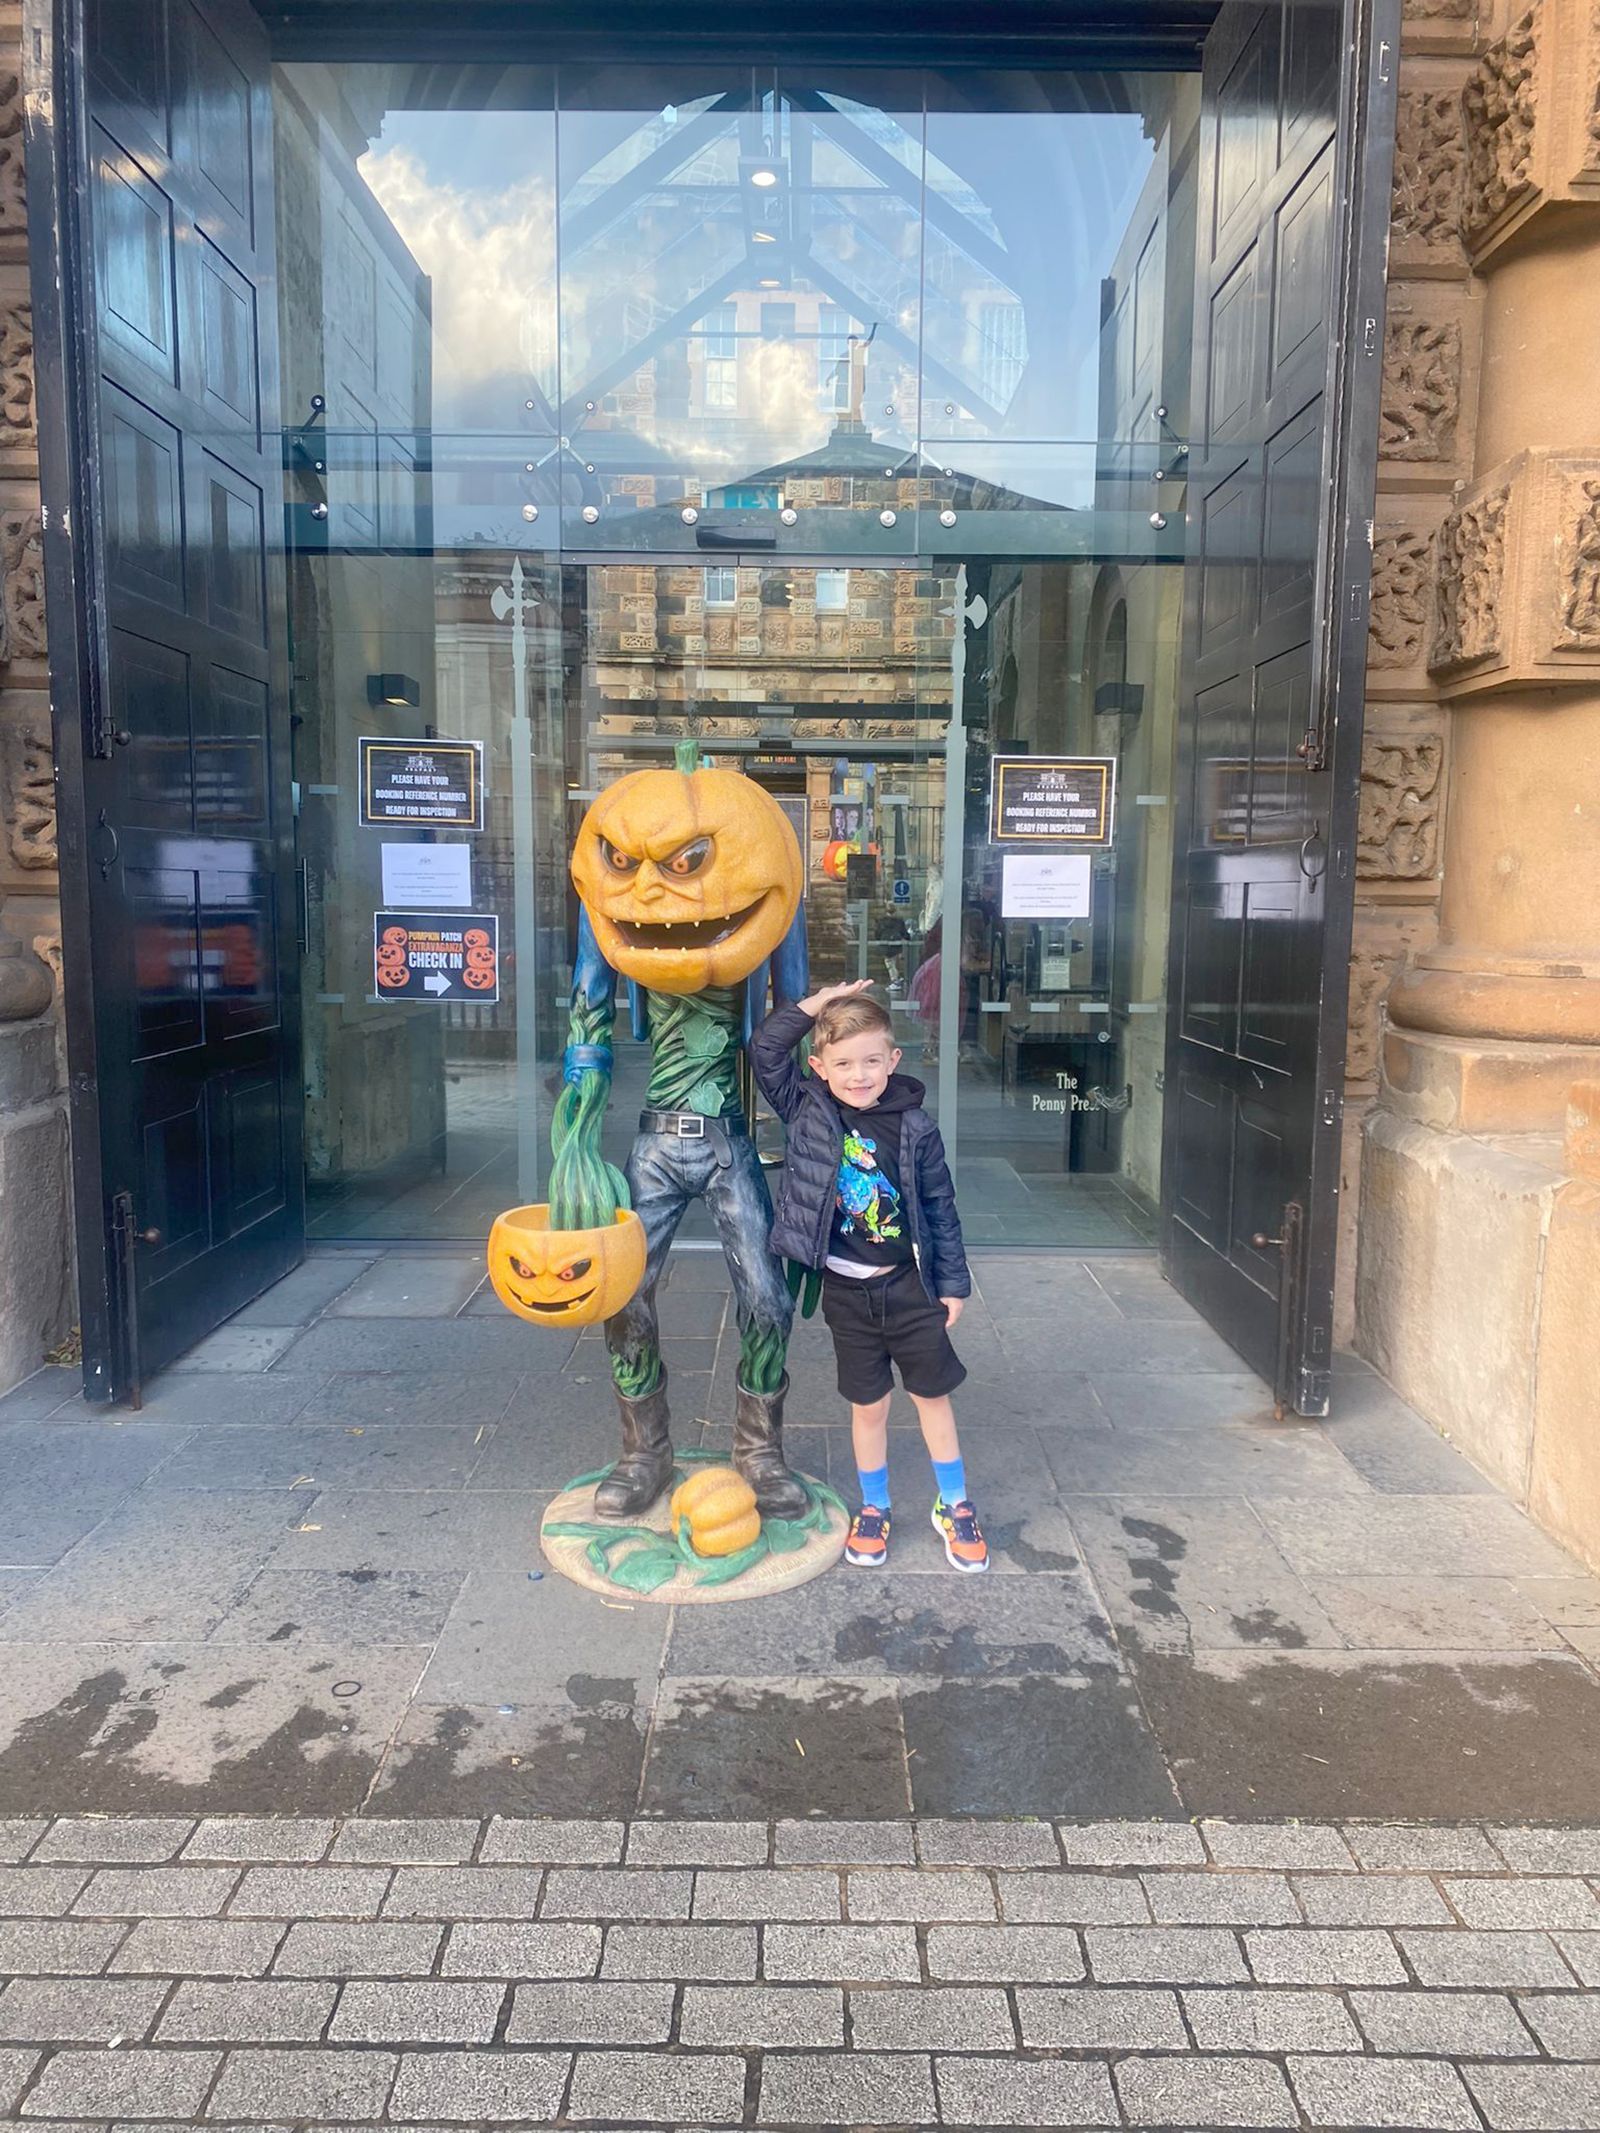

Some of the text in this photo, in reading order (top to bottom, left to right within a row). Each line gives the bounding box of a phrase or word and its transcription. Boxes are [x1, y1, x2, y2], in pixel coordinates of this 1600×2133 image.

[391, 774, 449, 786] PLEASE HAVE YOUR
[375, 790, 467, 802] BOOKING REFERENCE NUMBER
[1022, 792, 1080, 802] PLEASE HAVE YOUR
[386, 805, 457, 817] READY FOR INSPECTION
[1006, 807, 1097, 818] BOOKING REFERENCE NUMBER
[1016, 822, 1086, 834] READY FOR INSPECTION
[408, 931, 462, 942] PUMPKIN PATCH
[408, 942, 464, 953] EXTRAVAGANZA
[409, 952, 463, 969] CHECK IN
[1056, 1072, 1078, 1089] The
[1032, 1095, 1066, 1114] Penny
